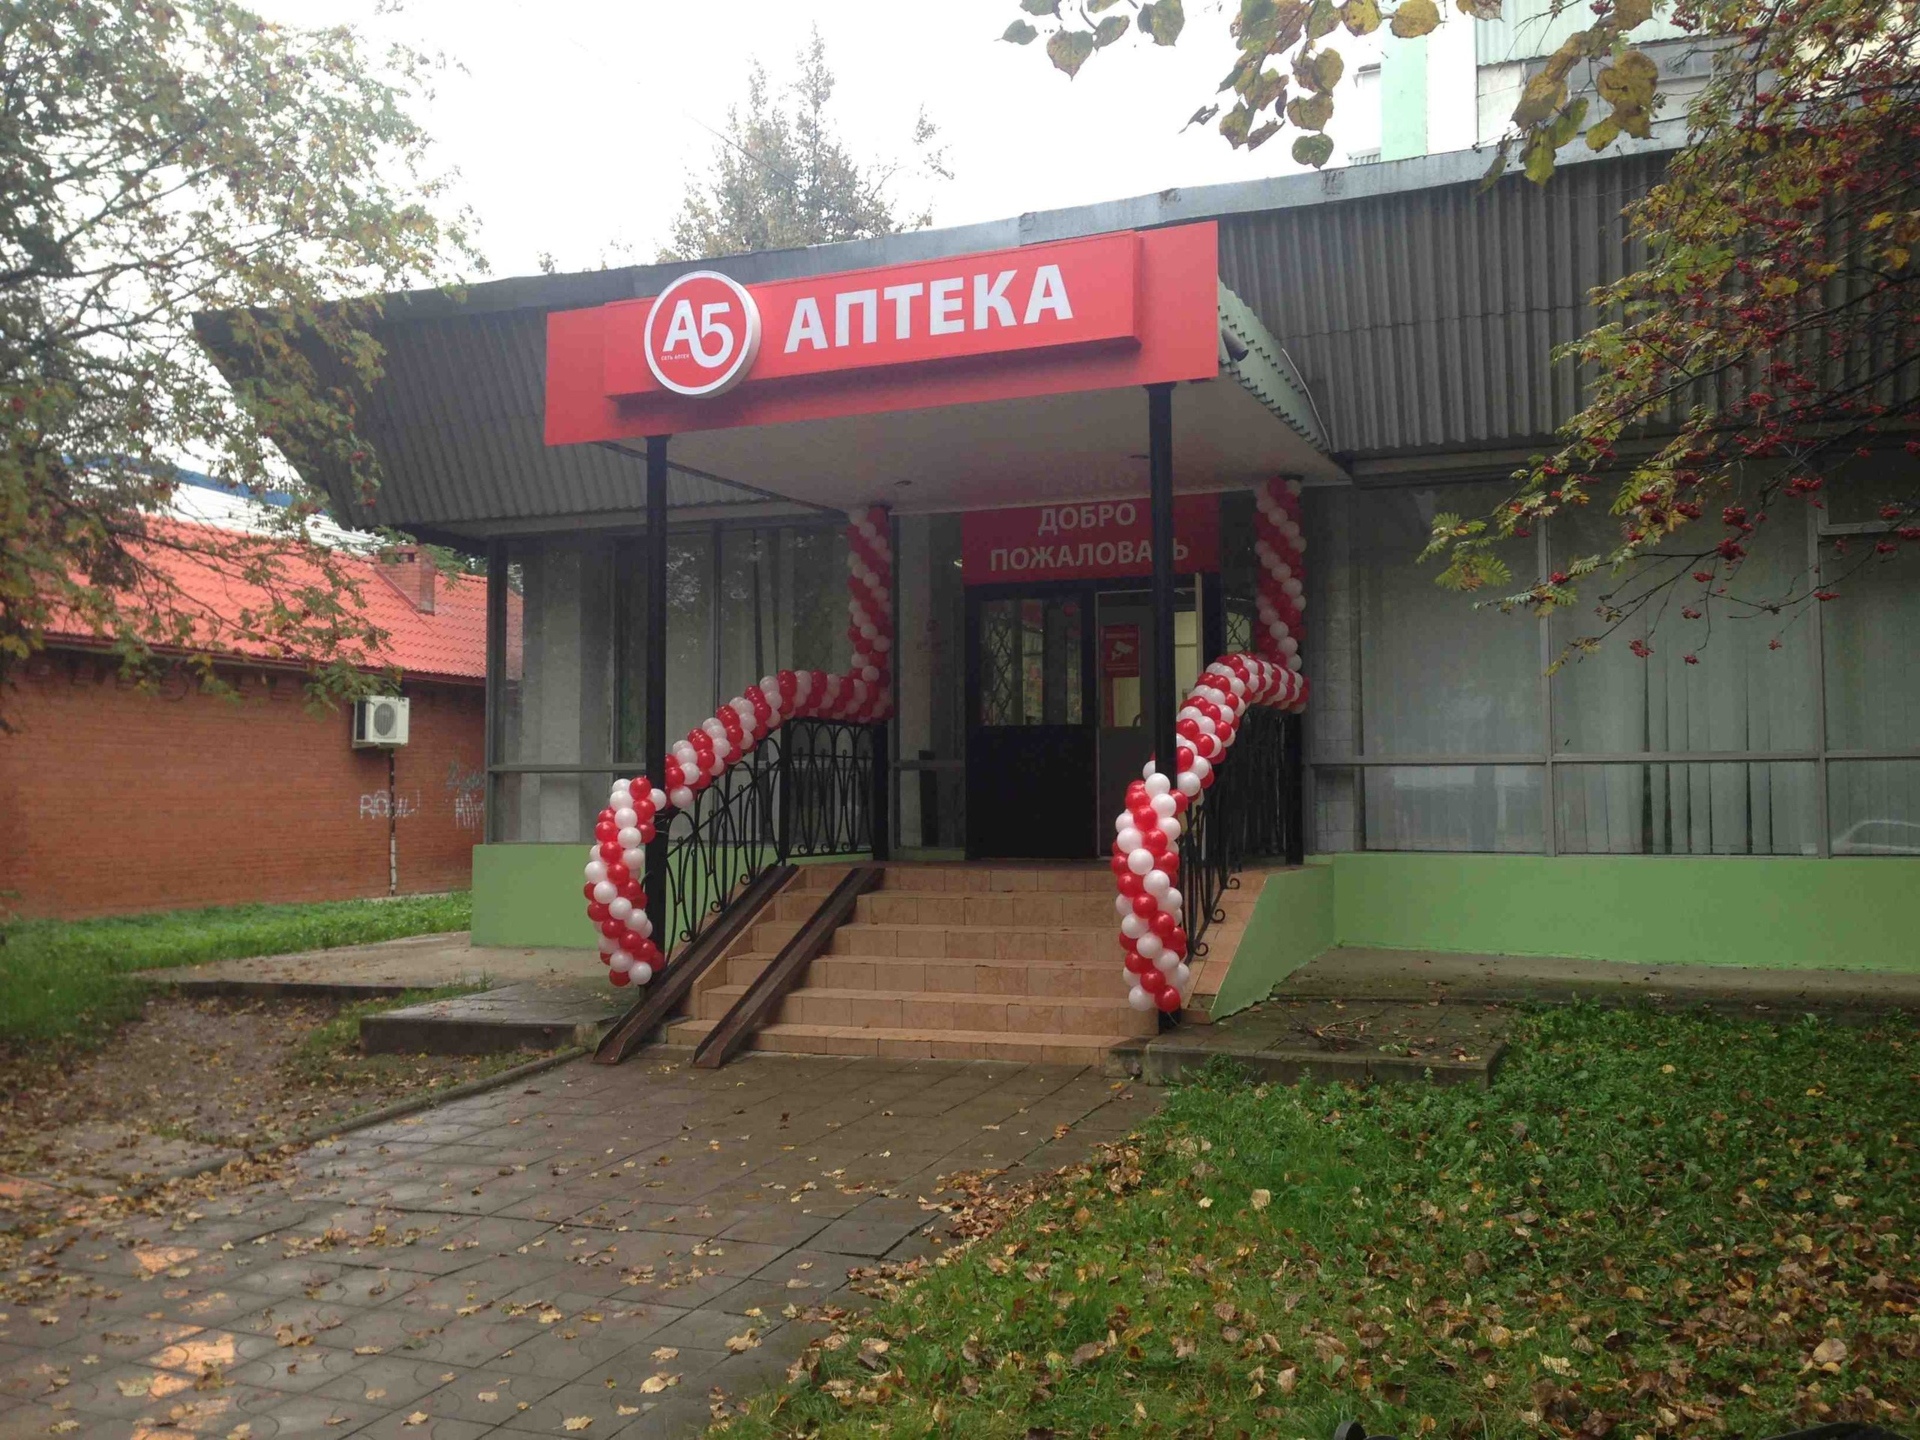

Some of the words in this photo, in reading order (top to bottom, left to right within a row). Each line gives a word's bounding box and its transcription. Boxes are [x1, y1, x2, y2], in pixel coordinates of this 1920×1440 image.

[662, 299, 734, 368] А5
[783, 264, 1074, 353] АПТЕКА
[1038, 502, 1136, 537] ДОБРО
[990, 538, 1189, 572] ПОЖАЛОВАЬ
